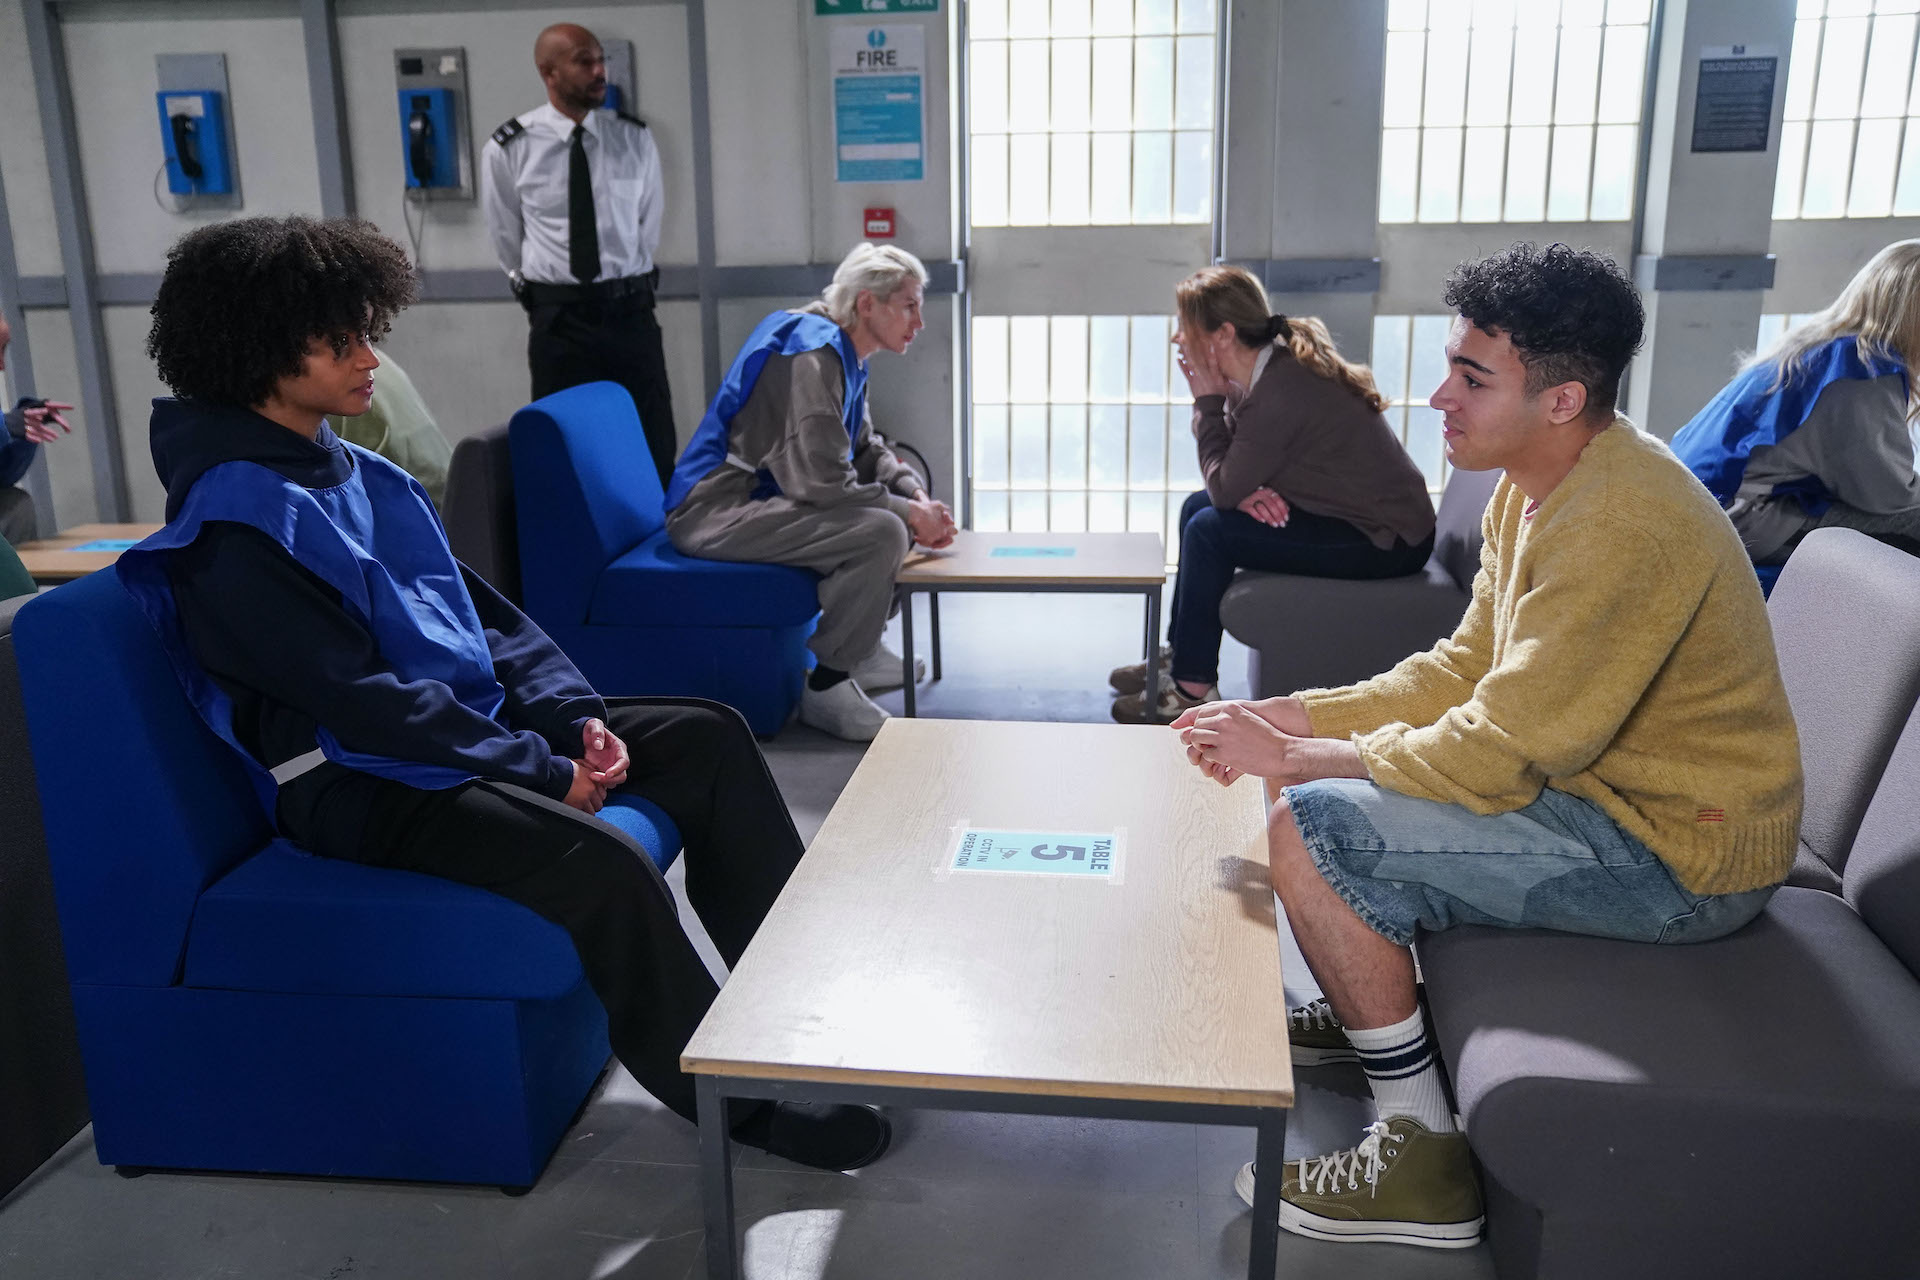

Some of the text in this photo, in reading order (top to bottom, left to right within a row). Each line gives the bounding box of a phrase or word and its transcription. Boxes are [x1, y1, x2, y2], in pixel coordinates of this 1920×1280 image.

[856, 50, 897, 66] FIRE
[956, 833, 977, 867] OPERATION
[979, 838, 993, 855] CCTV
[1030, 843, 1086, 861] 5
[1090, 839, 1111, 870] TABLE
